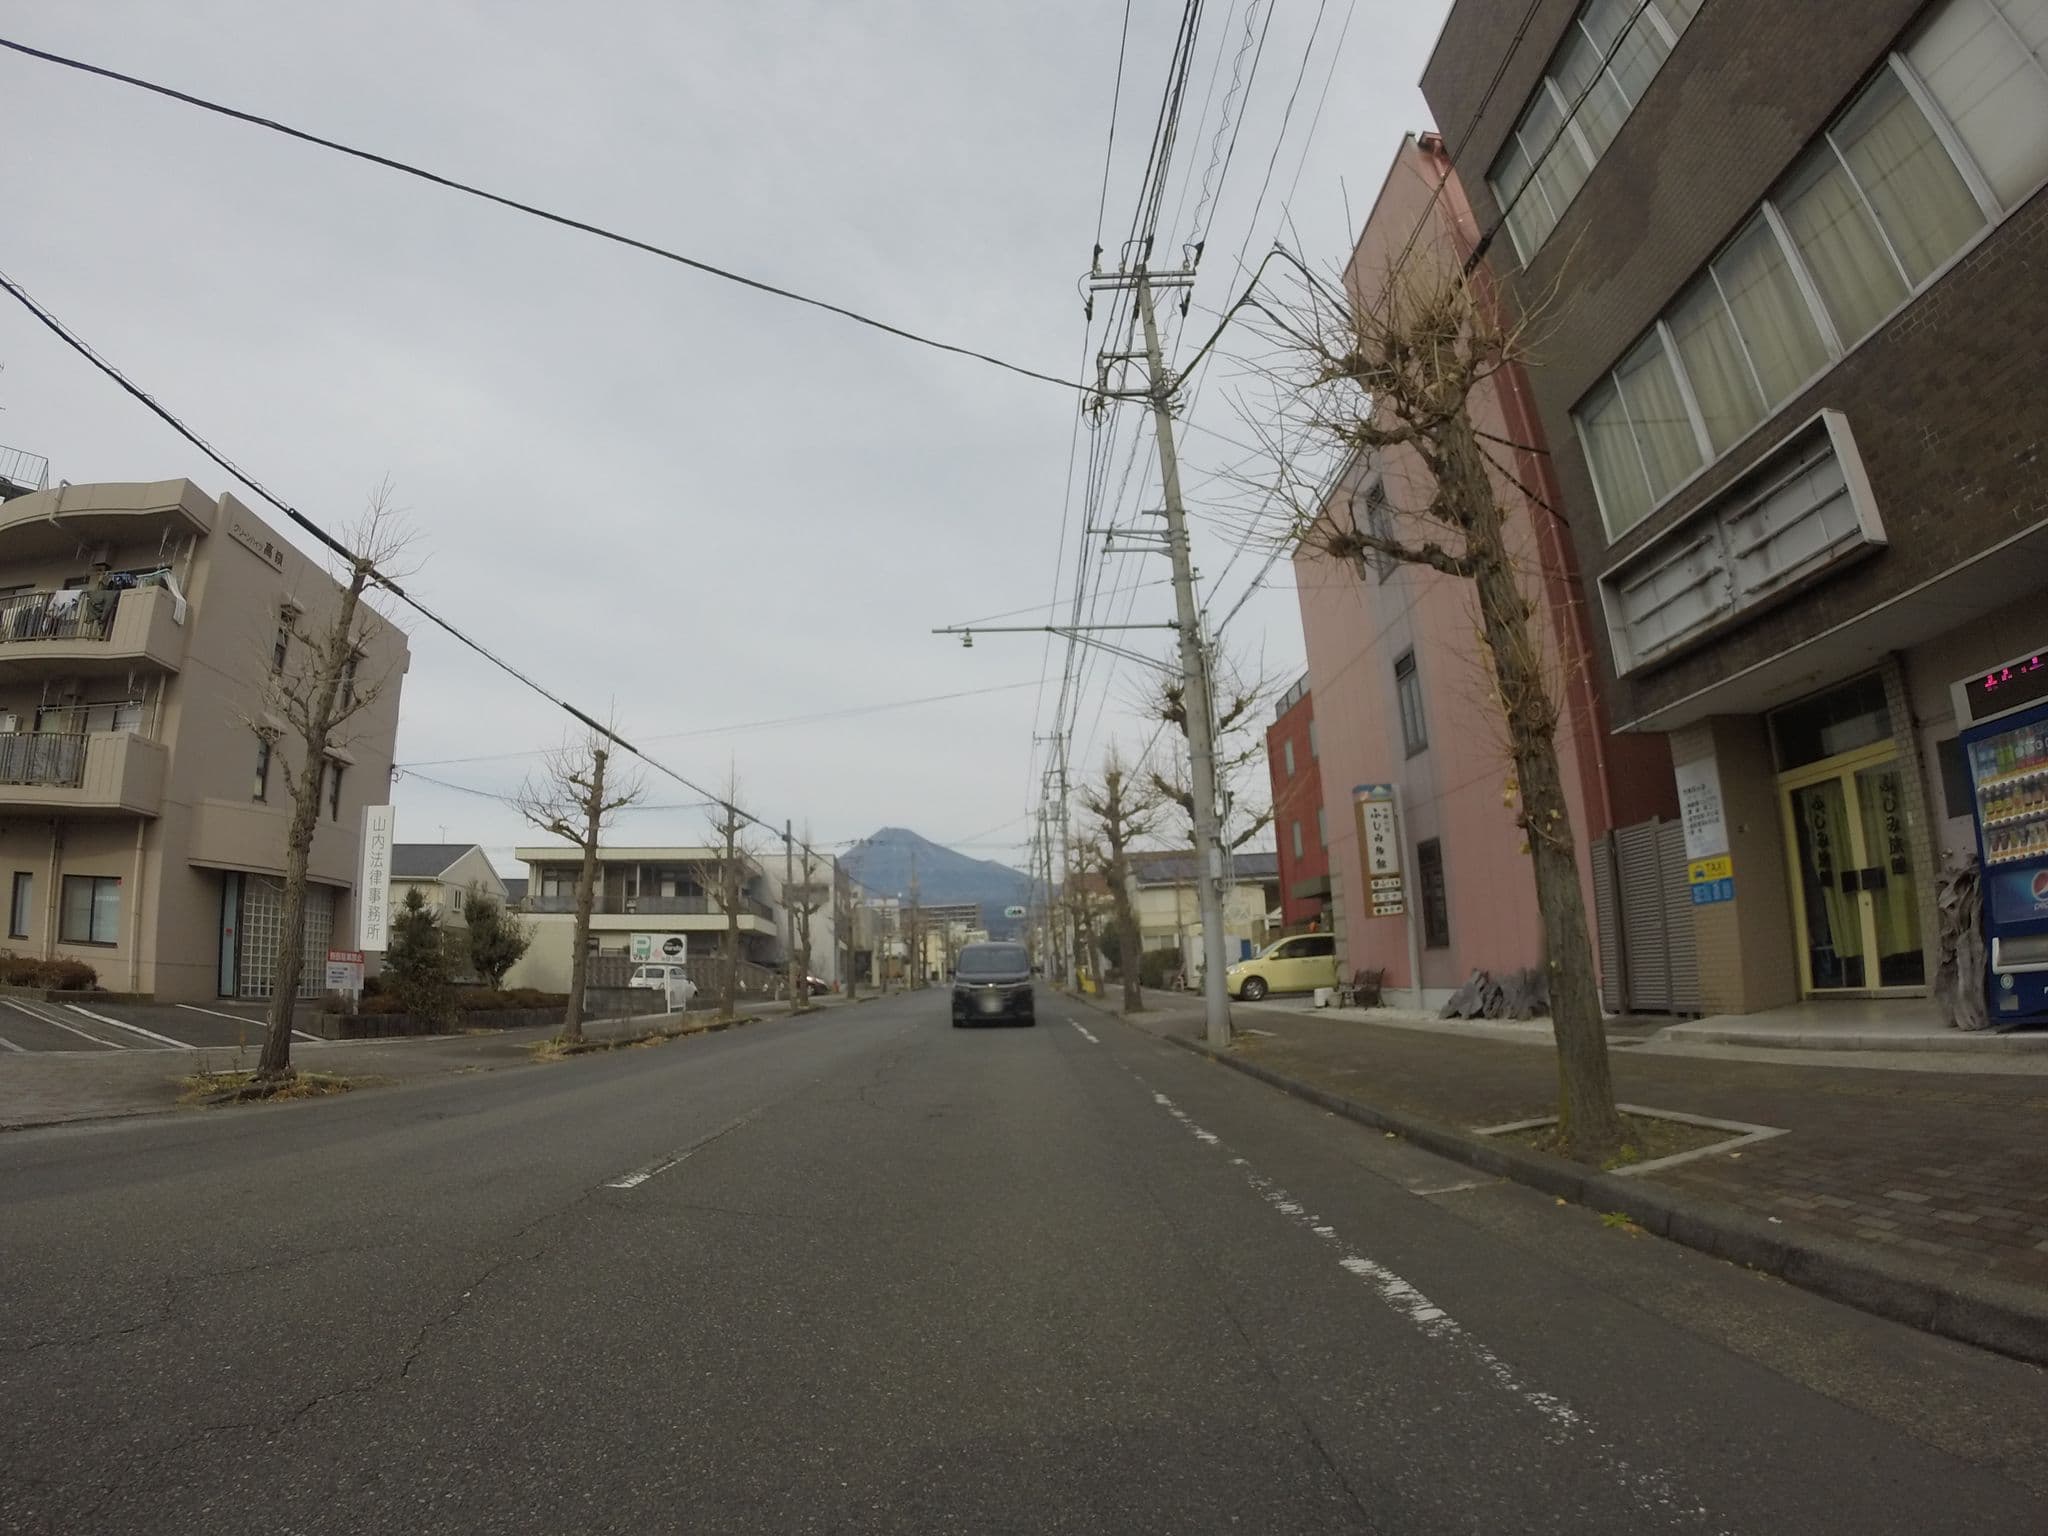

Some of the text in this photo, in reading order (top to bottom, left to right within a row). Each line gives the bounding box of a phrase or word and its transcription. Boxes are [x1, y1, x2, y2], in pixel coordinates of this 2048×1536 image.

[366, 816, 386, 941] 山内法律事務所
[1704, 860, 1727, 874] TAXI
